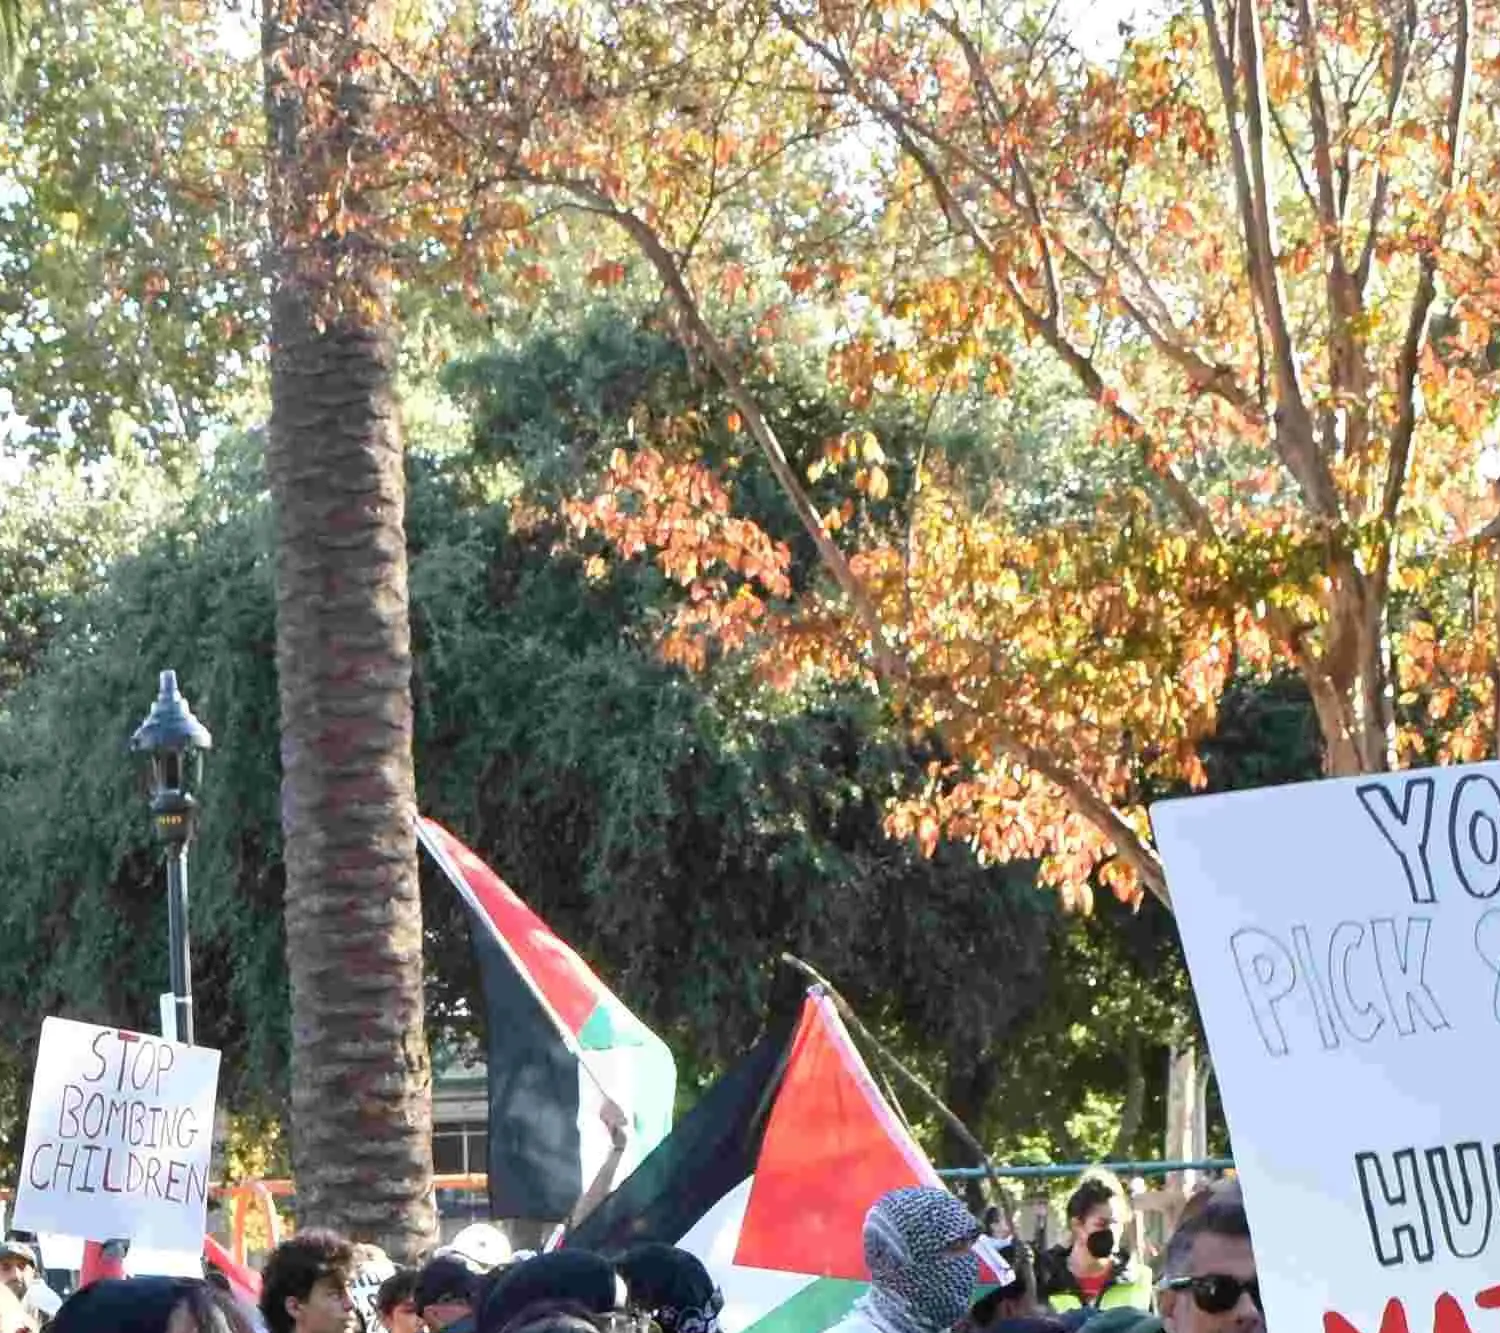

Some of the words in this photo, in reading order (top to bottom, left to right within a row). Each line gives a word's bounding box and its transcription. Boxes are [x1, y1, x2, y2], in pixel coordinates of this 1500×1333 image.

[1229, 915, 1451, 1057] PICK
[83, 1030, 175, 1096] STOP
[57, 1084, 199, 1149] BOMBING
[28, 1142, 208, 1206] CHILDREN
